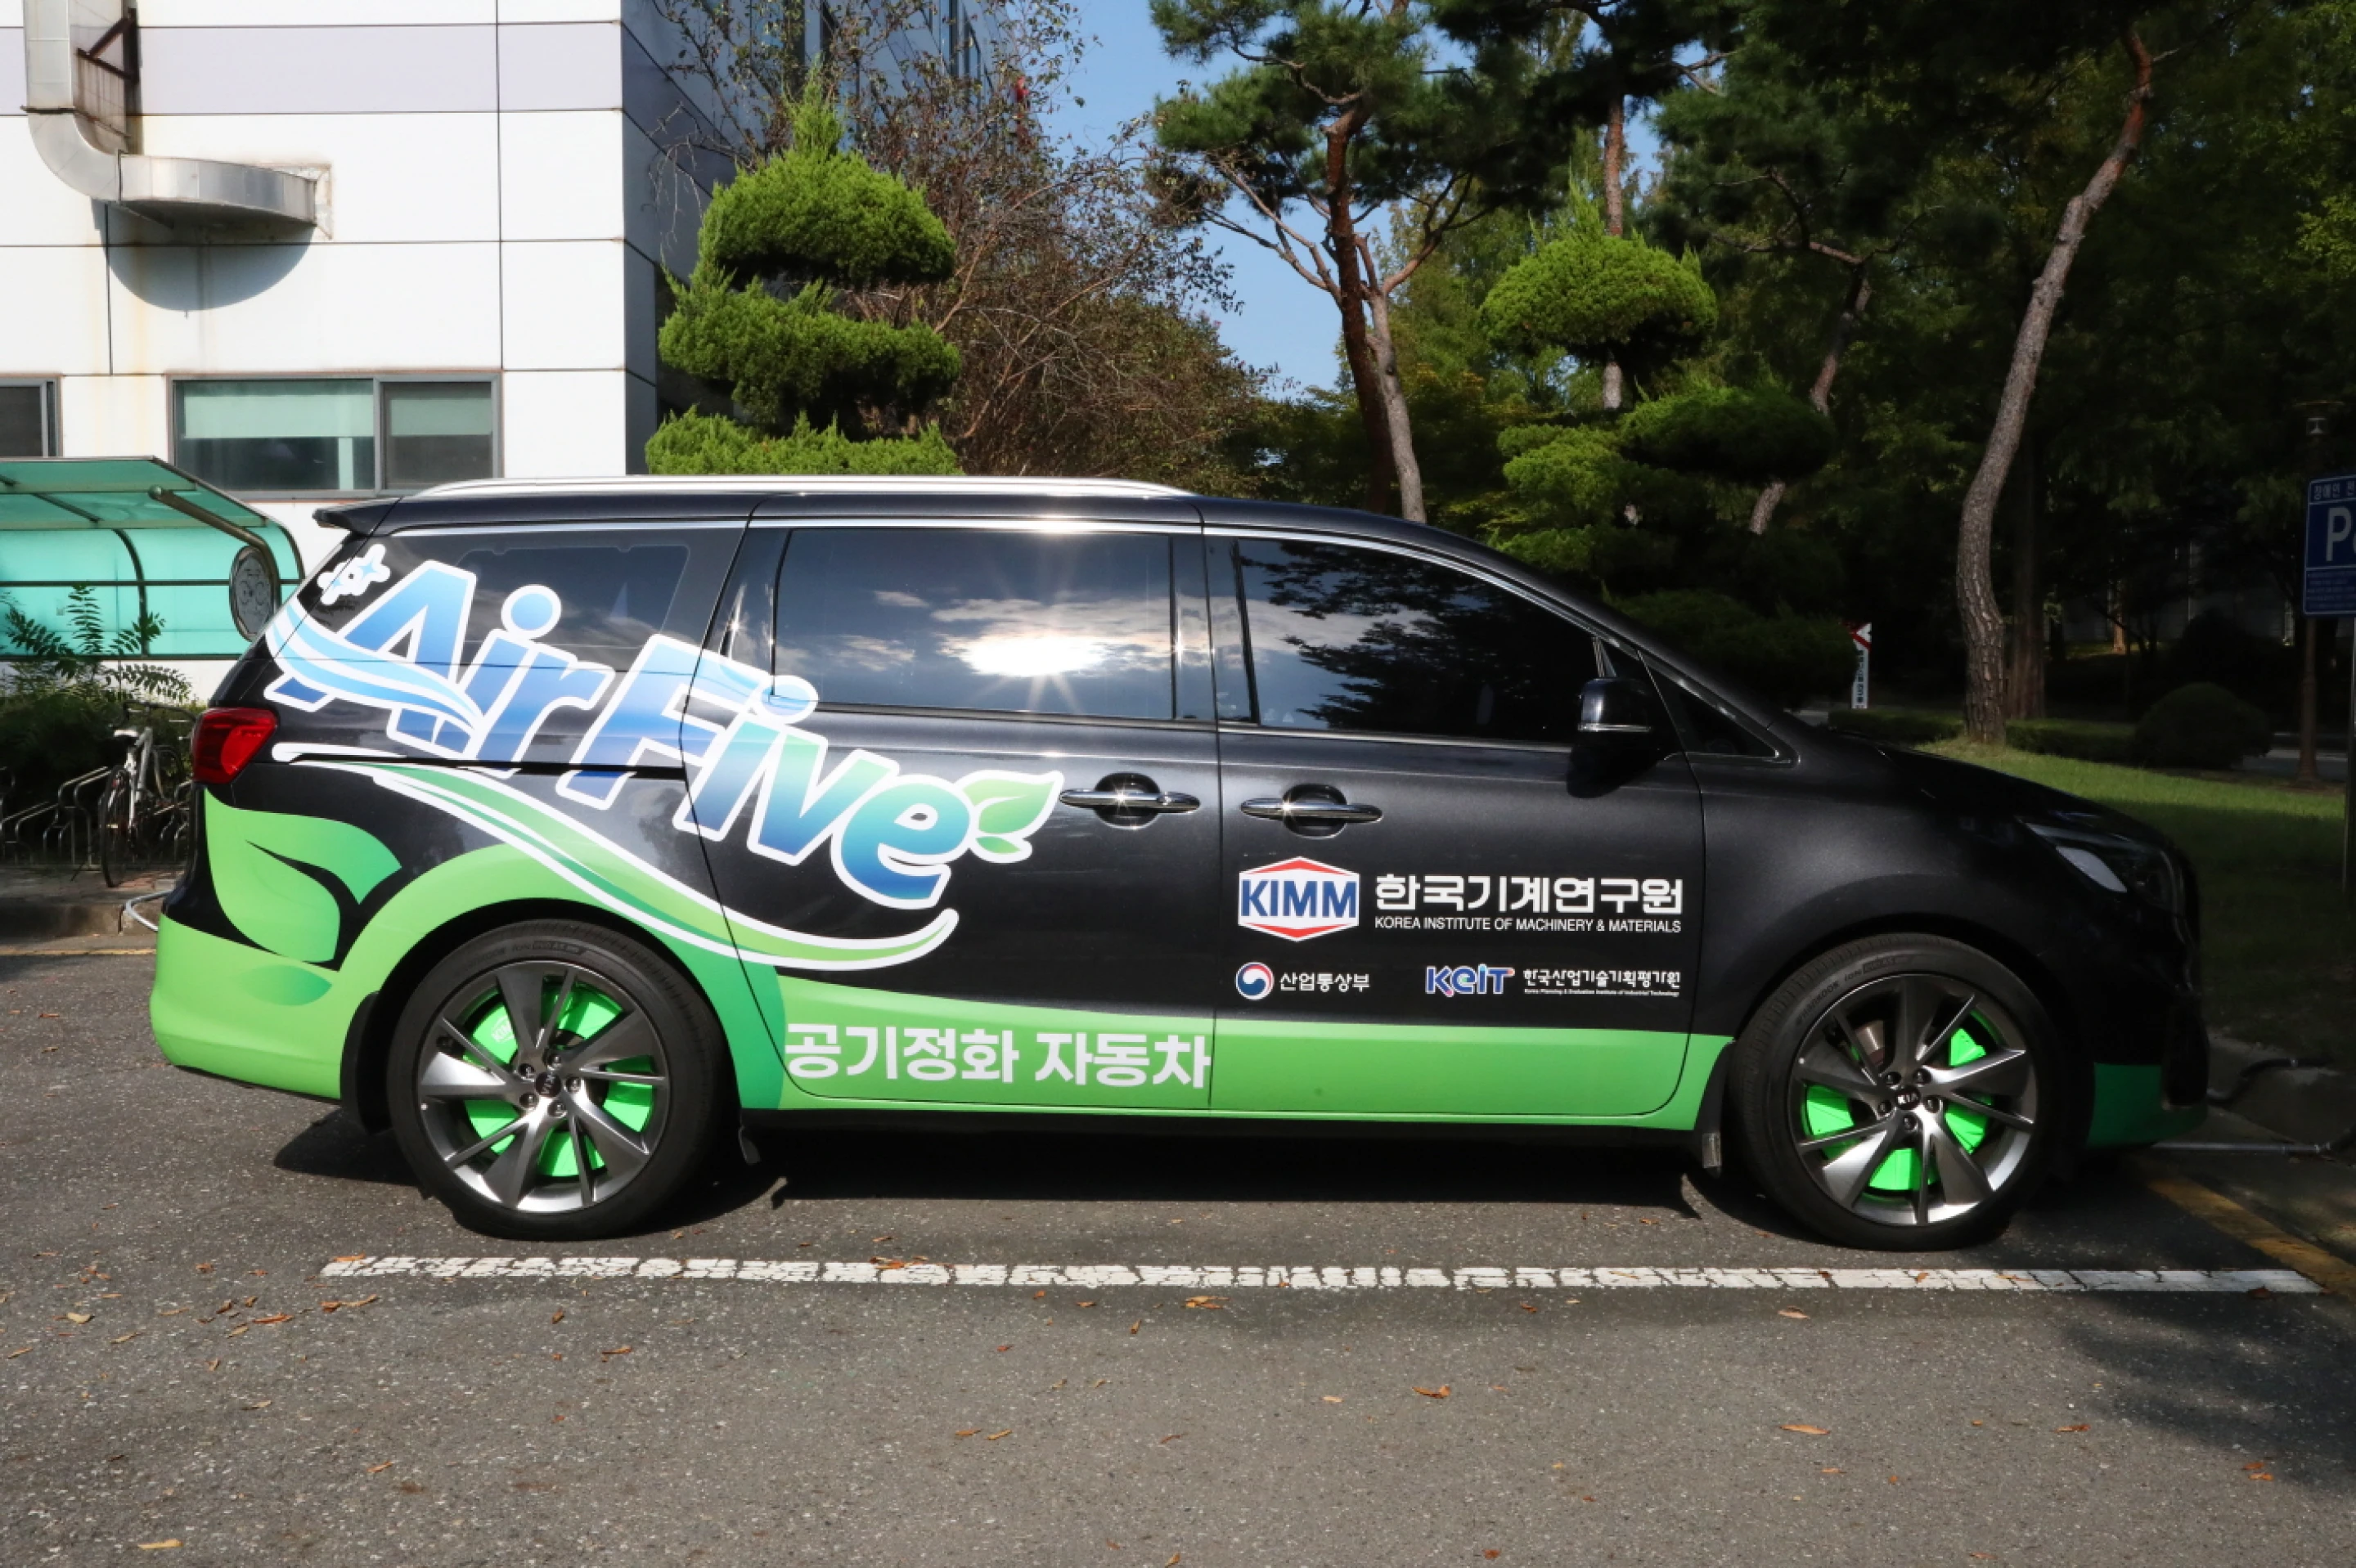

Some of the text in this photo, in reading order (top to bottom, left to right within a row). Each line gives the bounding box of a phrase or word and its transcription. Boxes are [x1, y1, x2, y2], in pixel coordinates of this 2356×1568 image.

[265, 559, 972, 910] AirFive
[1240, 878, 1357, 919] KIMM
[1375, 874, 1683, 915] 한국기계연구원
[1375, 916, 1681, 933] KOREA INSTITUTE OF MACHINERY & MATERIALS
[1279, 973, 1370, 992] 산업통상부
[785, 1022, 1212, 1089] 공기정화 자동차
